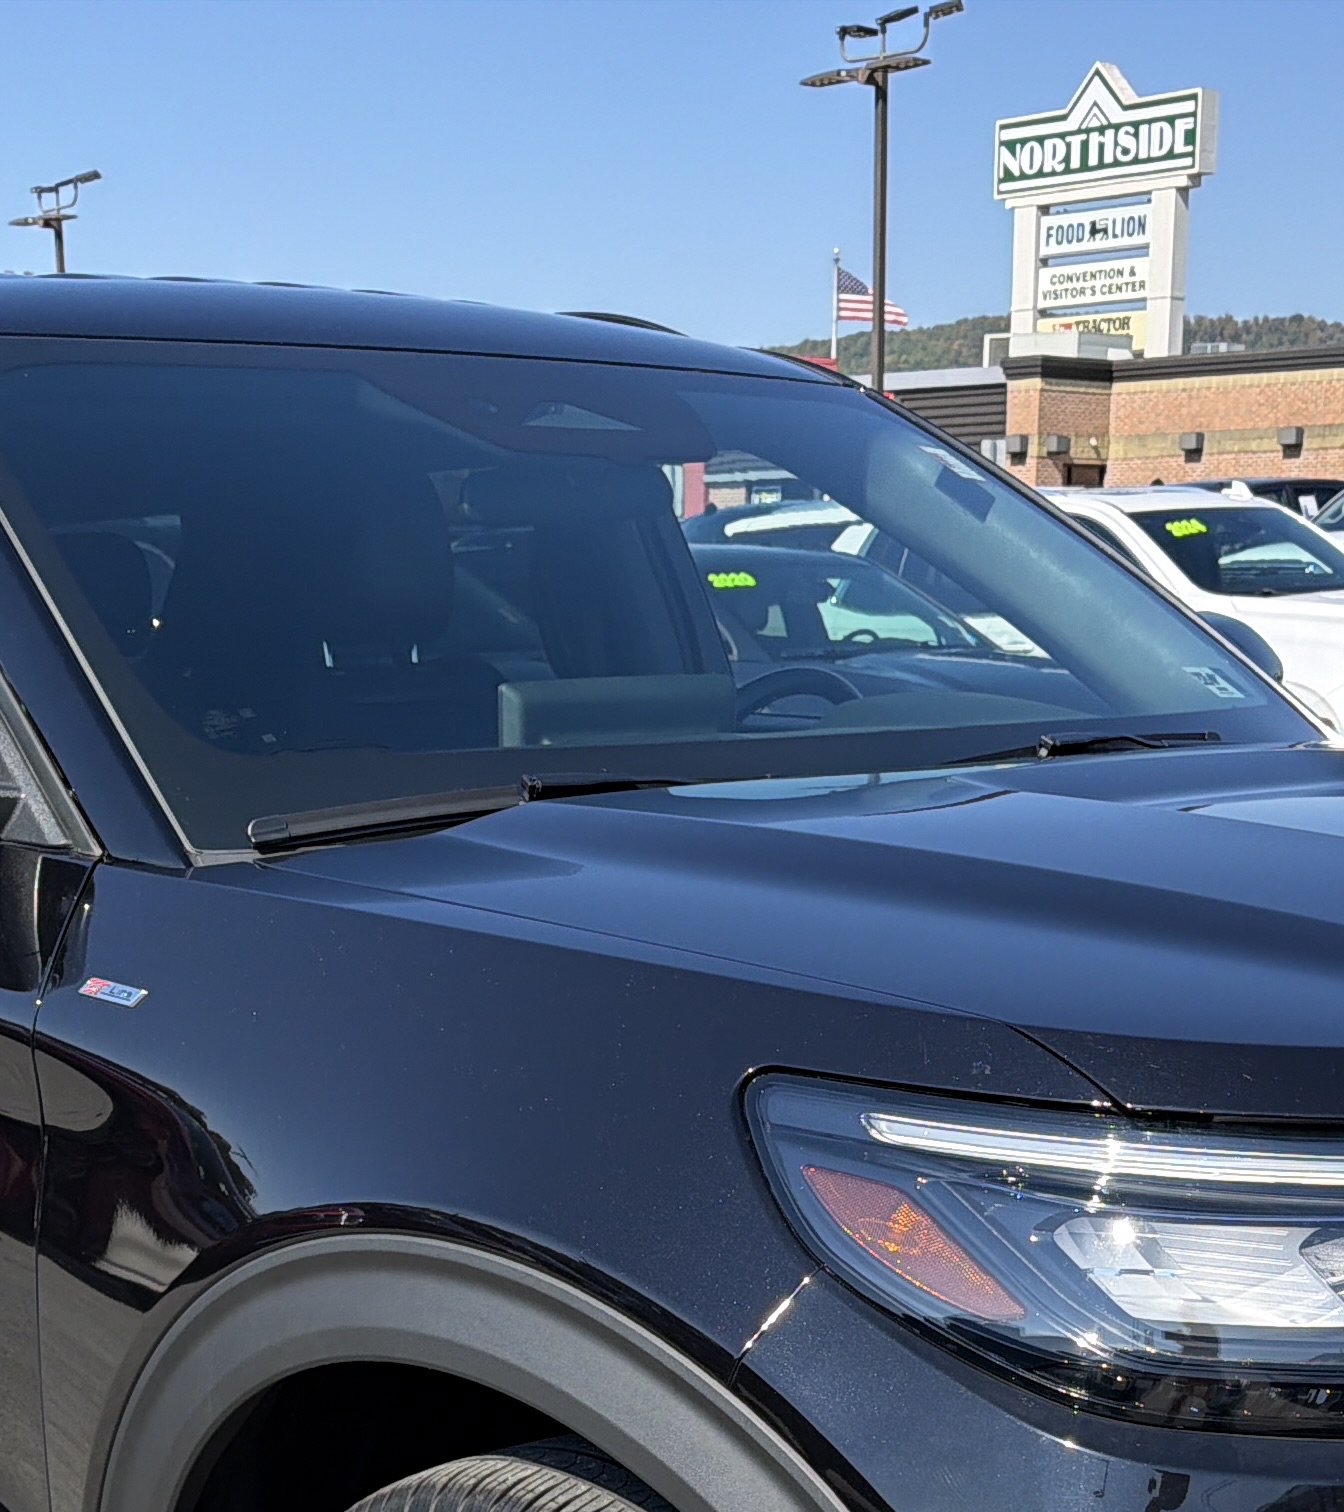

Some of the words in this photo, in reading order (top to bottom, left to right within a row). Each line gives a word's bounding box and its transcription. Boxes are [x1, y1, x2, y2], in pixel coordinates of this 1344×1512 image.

[999, 116, 1195, 179] NORTHSIDE
[1045, 222, 1085, 247] FOOD
[1111, 214, 1147, 240] LION
[1049, 267, 1124, 286] CONVENTION
[1128, 265, 1137, 278] &
[1041, 285, 1096, 301] VISITOR'S
[1099, 280, 1146, 296] CENTER
[1074, 316, 1131, 334] TRACTOR
